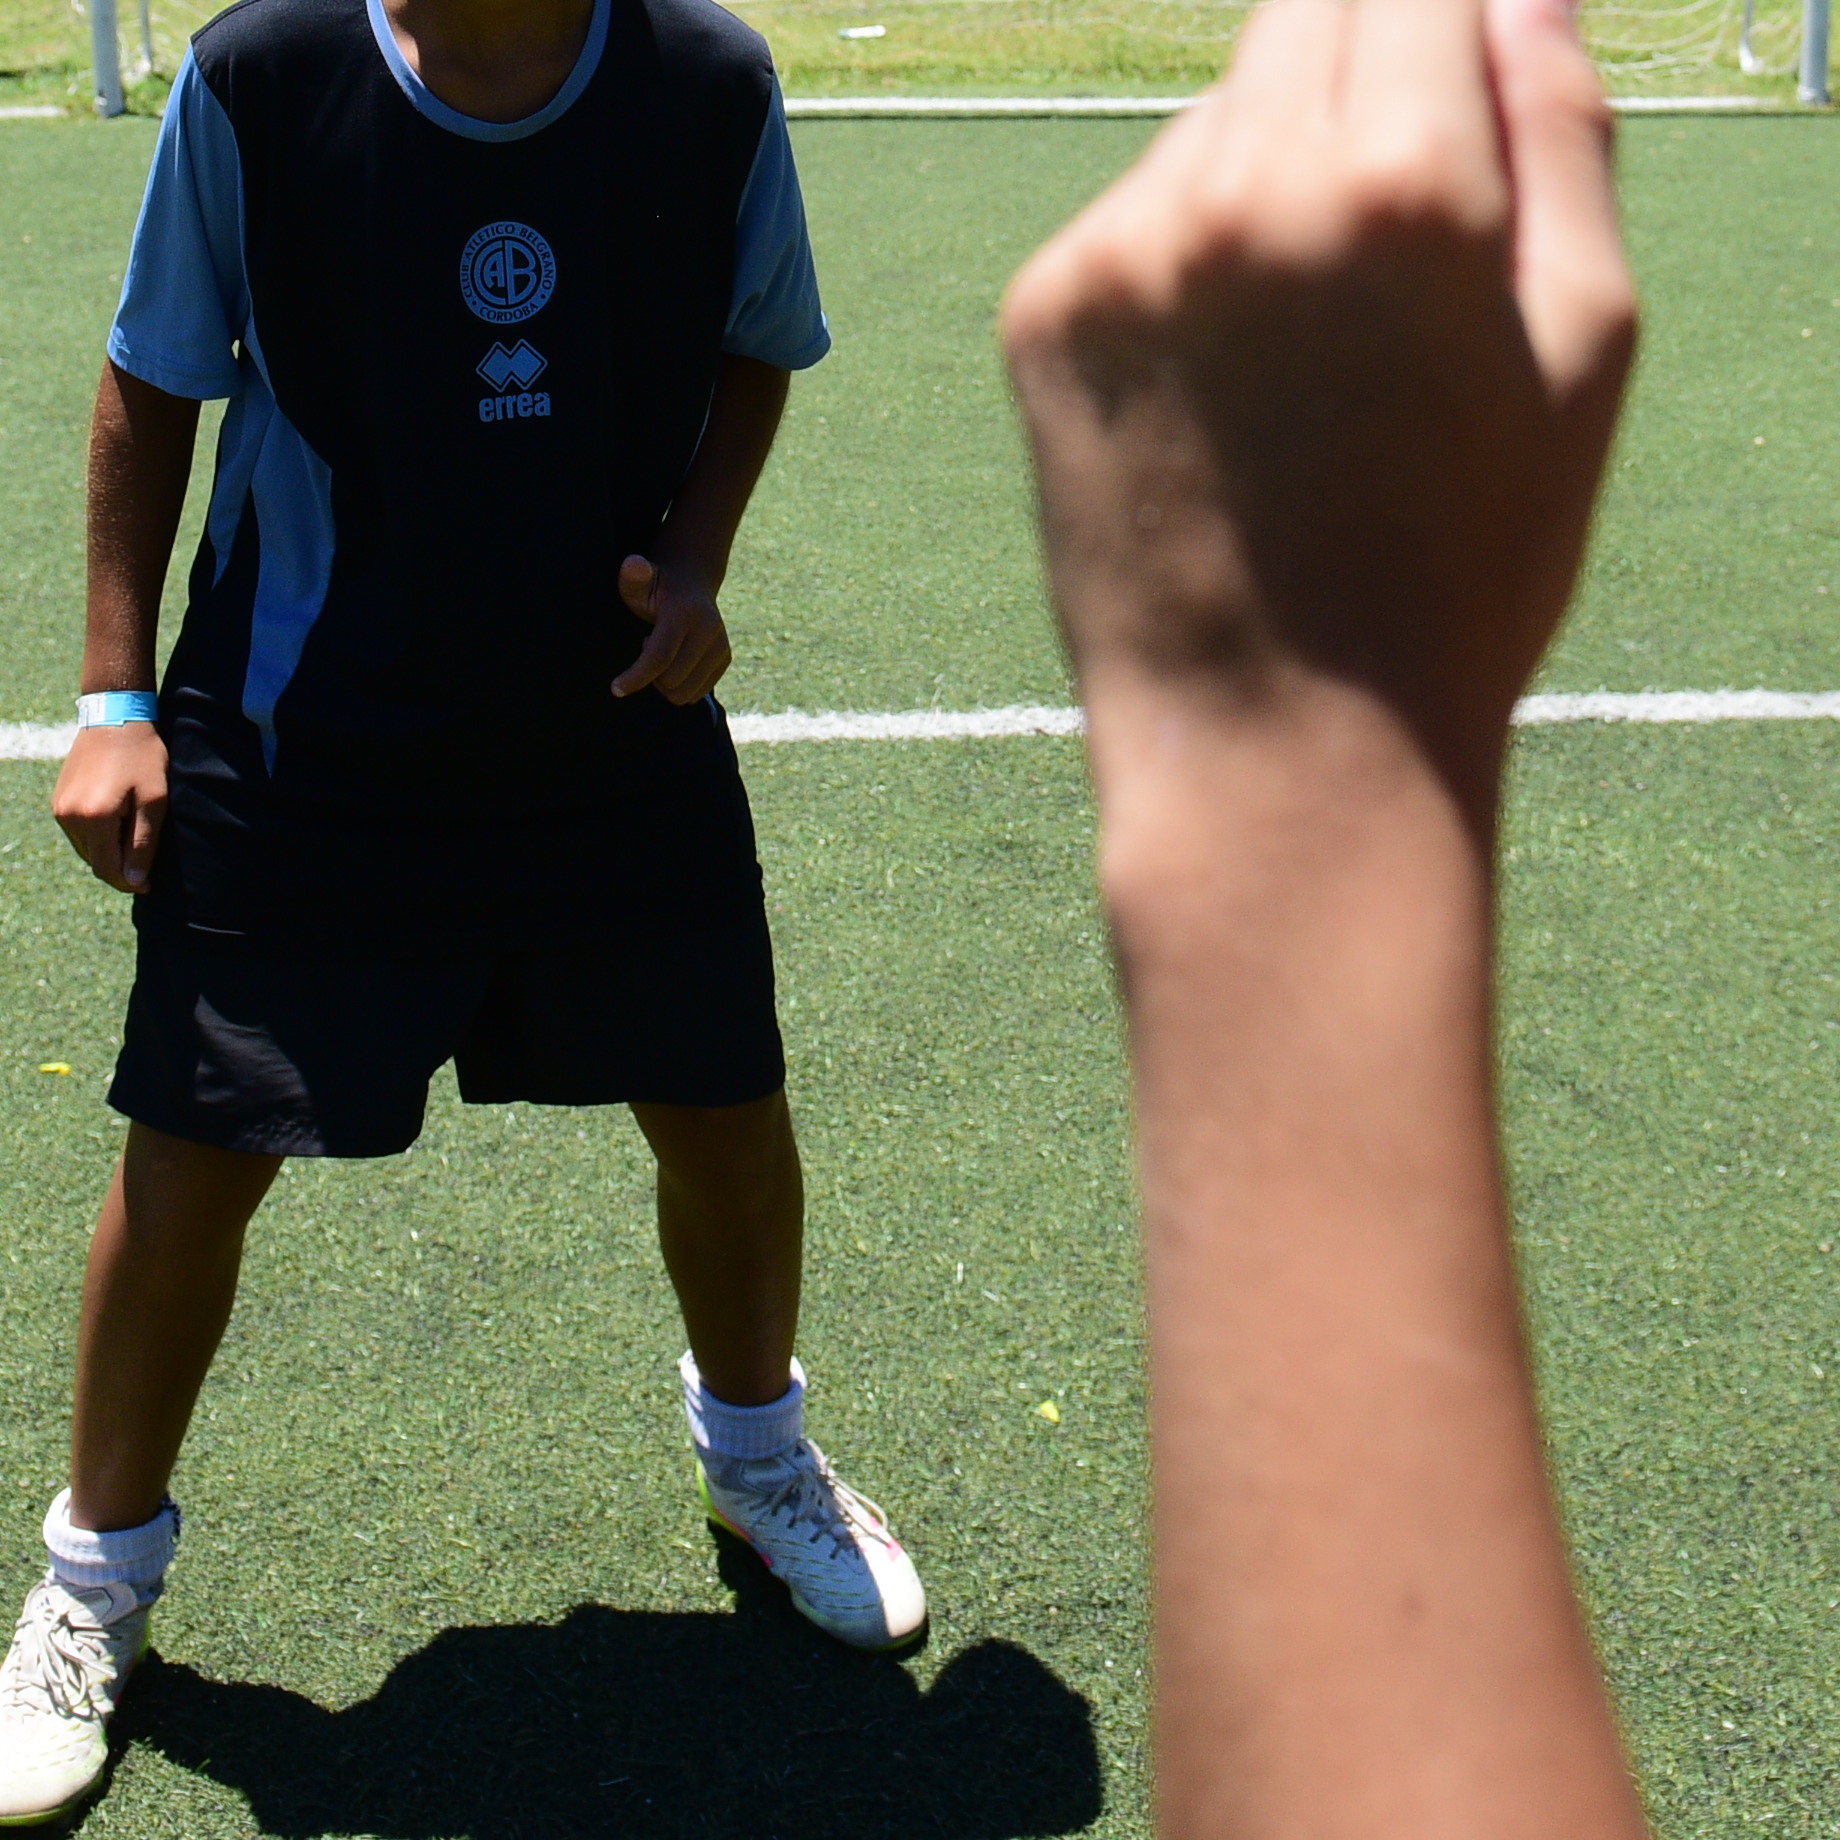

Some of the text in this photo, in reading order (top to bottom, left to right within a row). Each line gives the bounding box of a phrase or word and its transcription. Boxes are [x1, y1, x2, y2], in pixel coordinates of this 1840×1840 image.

[461, 264, 474, 299] CLUB
[519, 226, 554, 291] BELGRANO
[480, 301, 540, 322] CORDOBA
